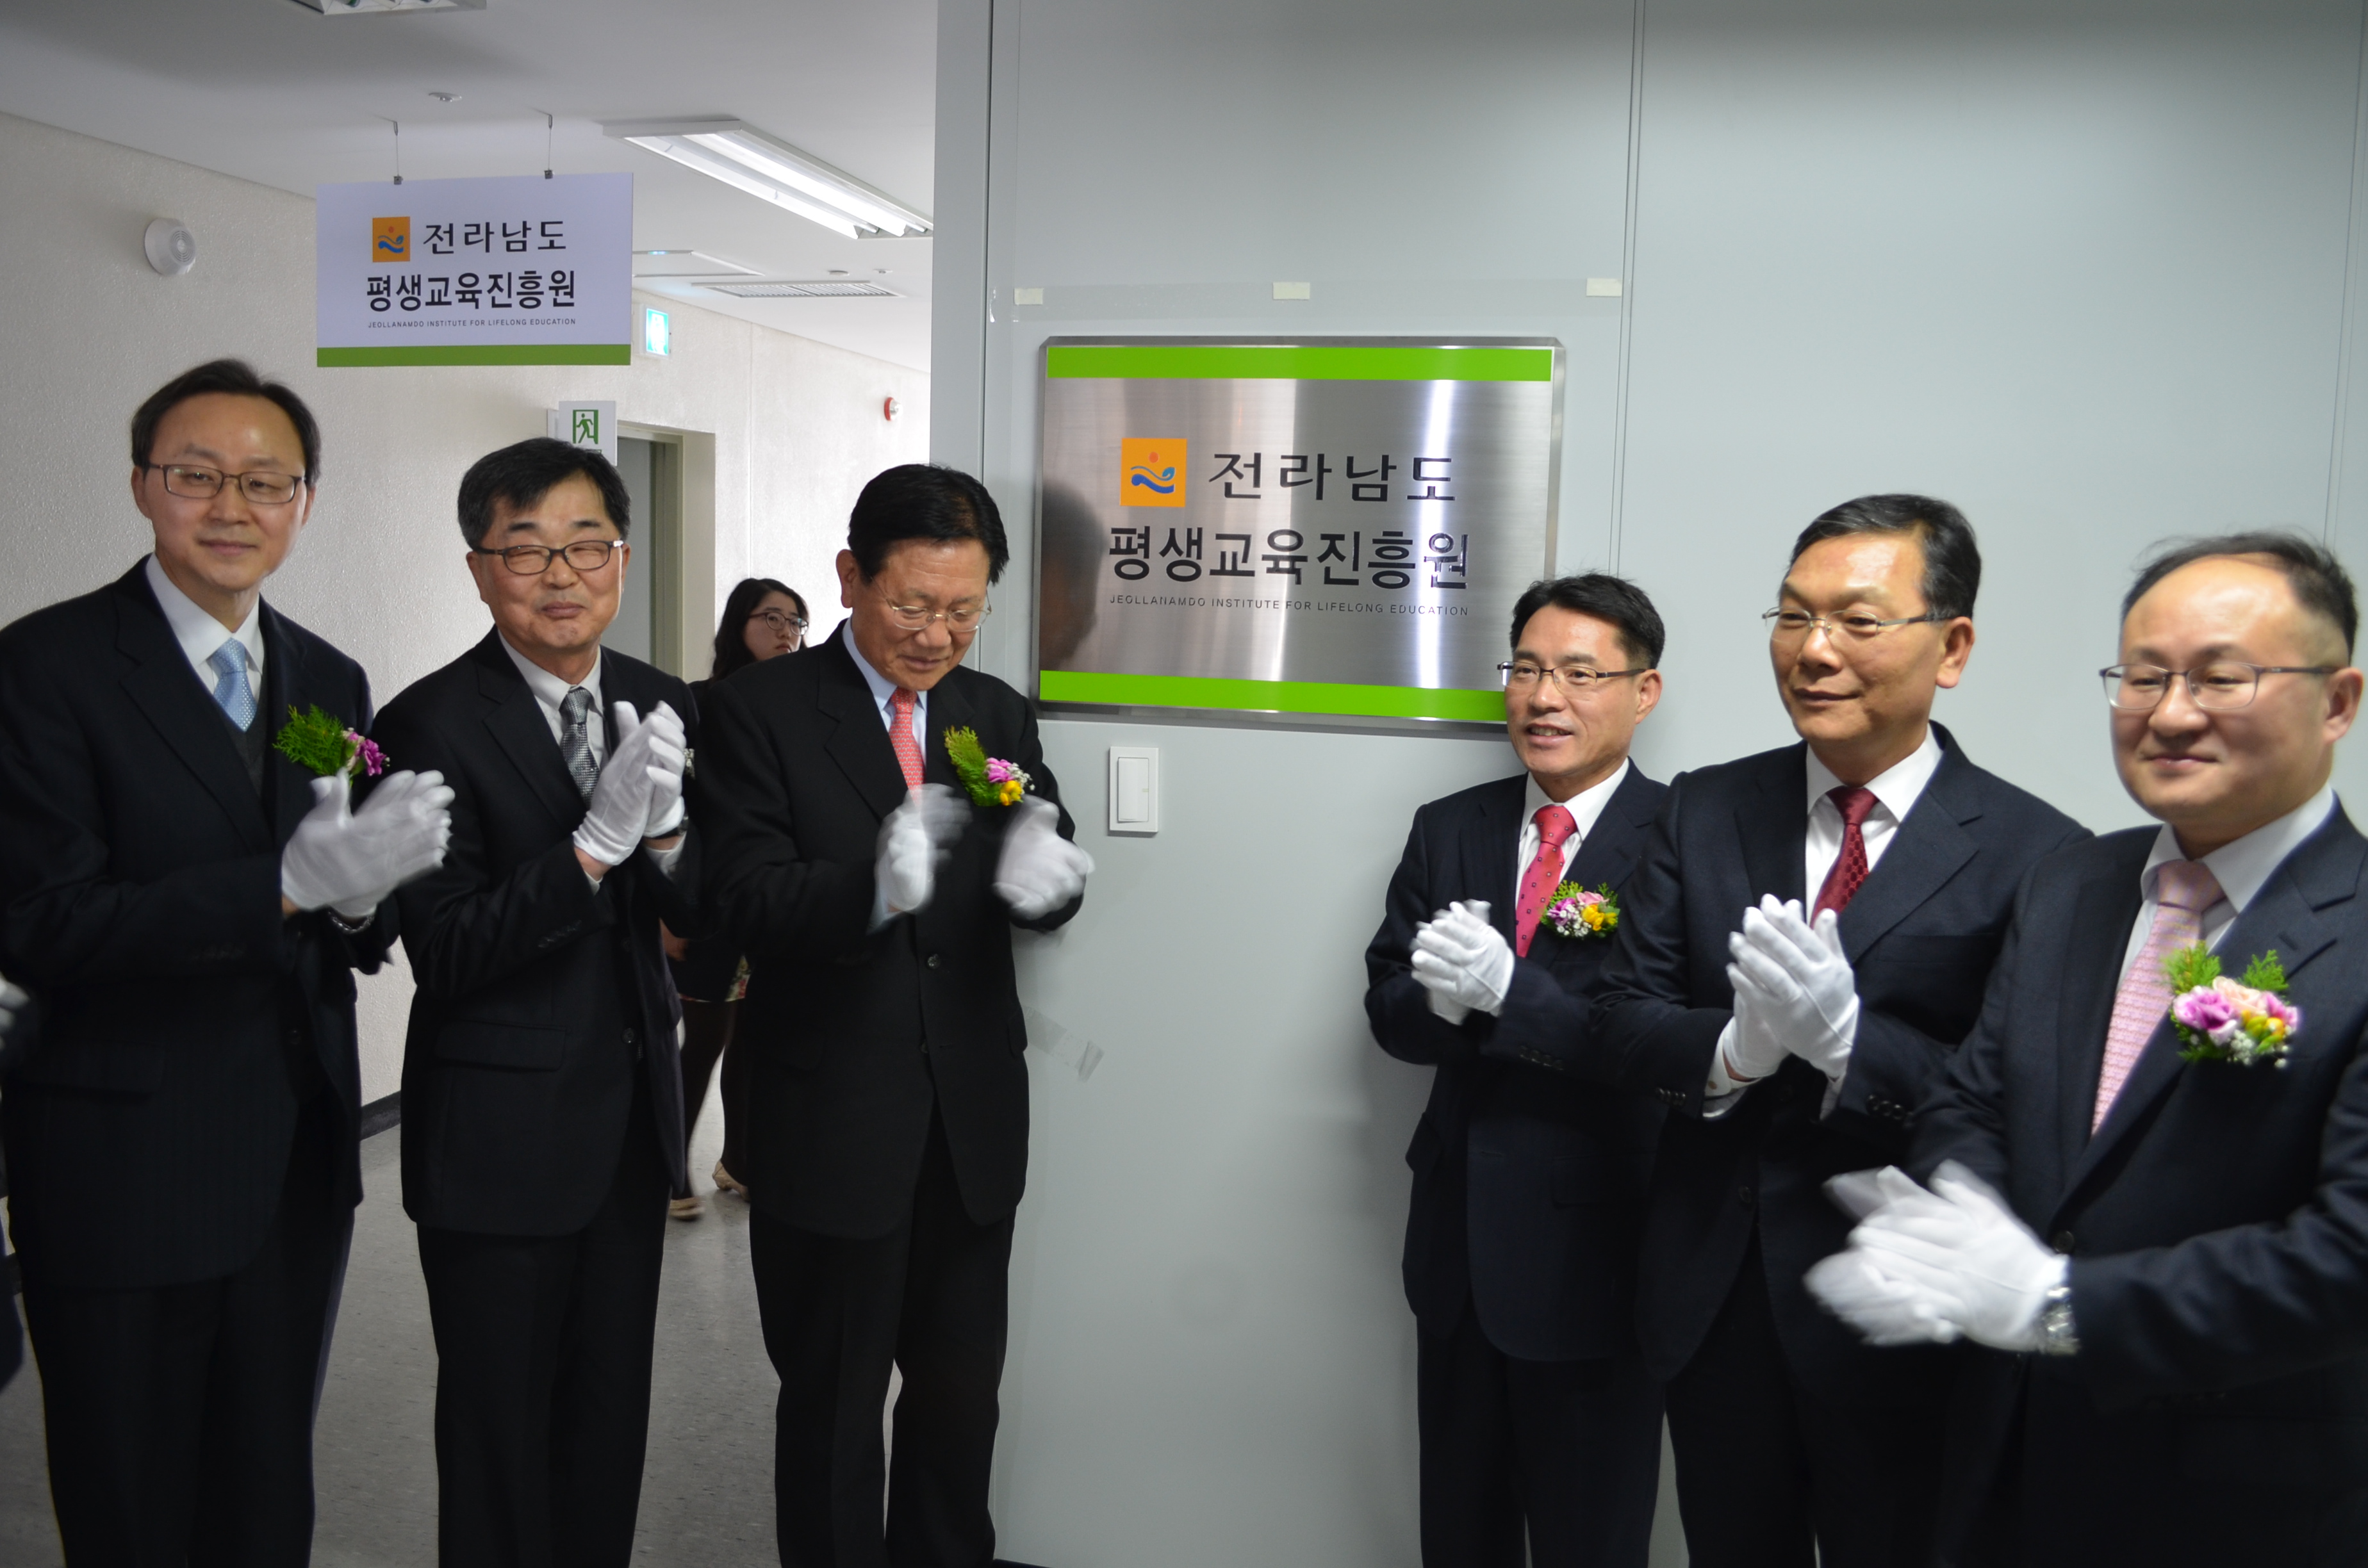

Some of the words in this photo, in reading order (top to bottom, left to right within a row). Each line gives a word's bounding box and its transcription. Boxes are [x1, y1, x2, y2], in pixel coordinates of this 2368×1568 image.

[422, 220, 567, 255] 전라남도
[366, 270, 575, 312] 평생교육진흥원
[1208, 452, 1456, 502] 전라남도
[1109, 525, 1468, 589] 평생교육진흥원
[1110, 594, 1206, 607] JEOLLANAMDO
[1212, 598, 1279, 609] INSTITUTE
[1286, 601, 1311, 610] FOR
[1317, 601, 1383, 613] LIFELONG
[1390, 604, 1468, 616] EDUCATION
